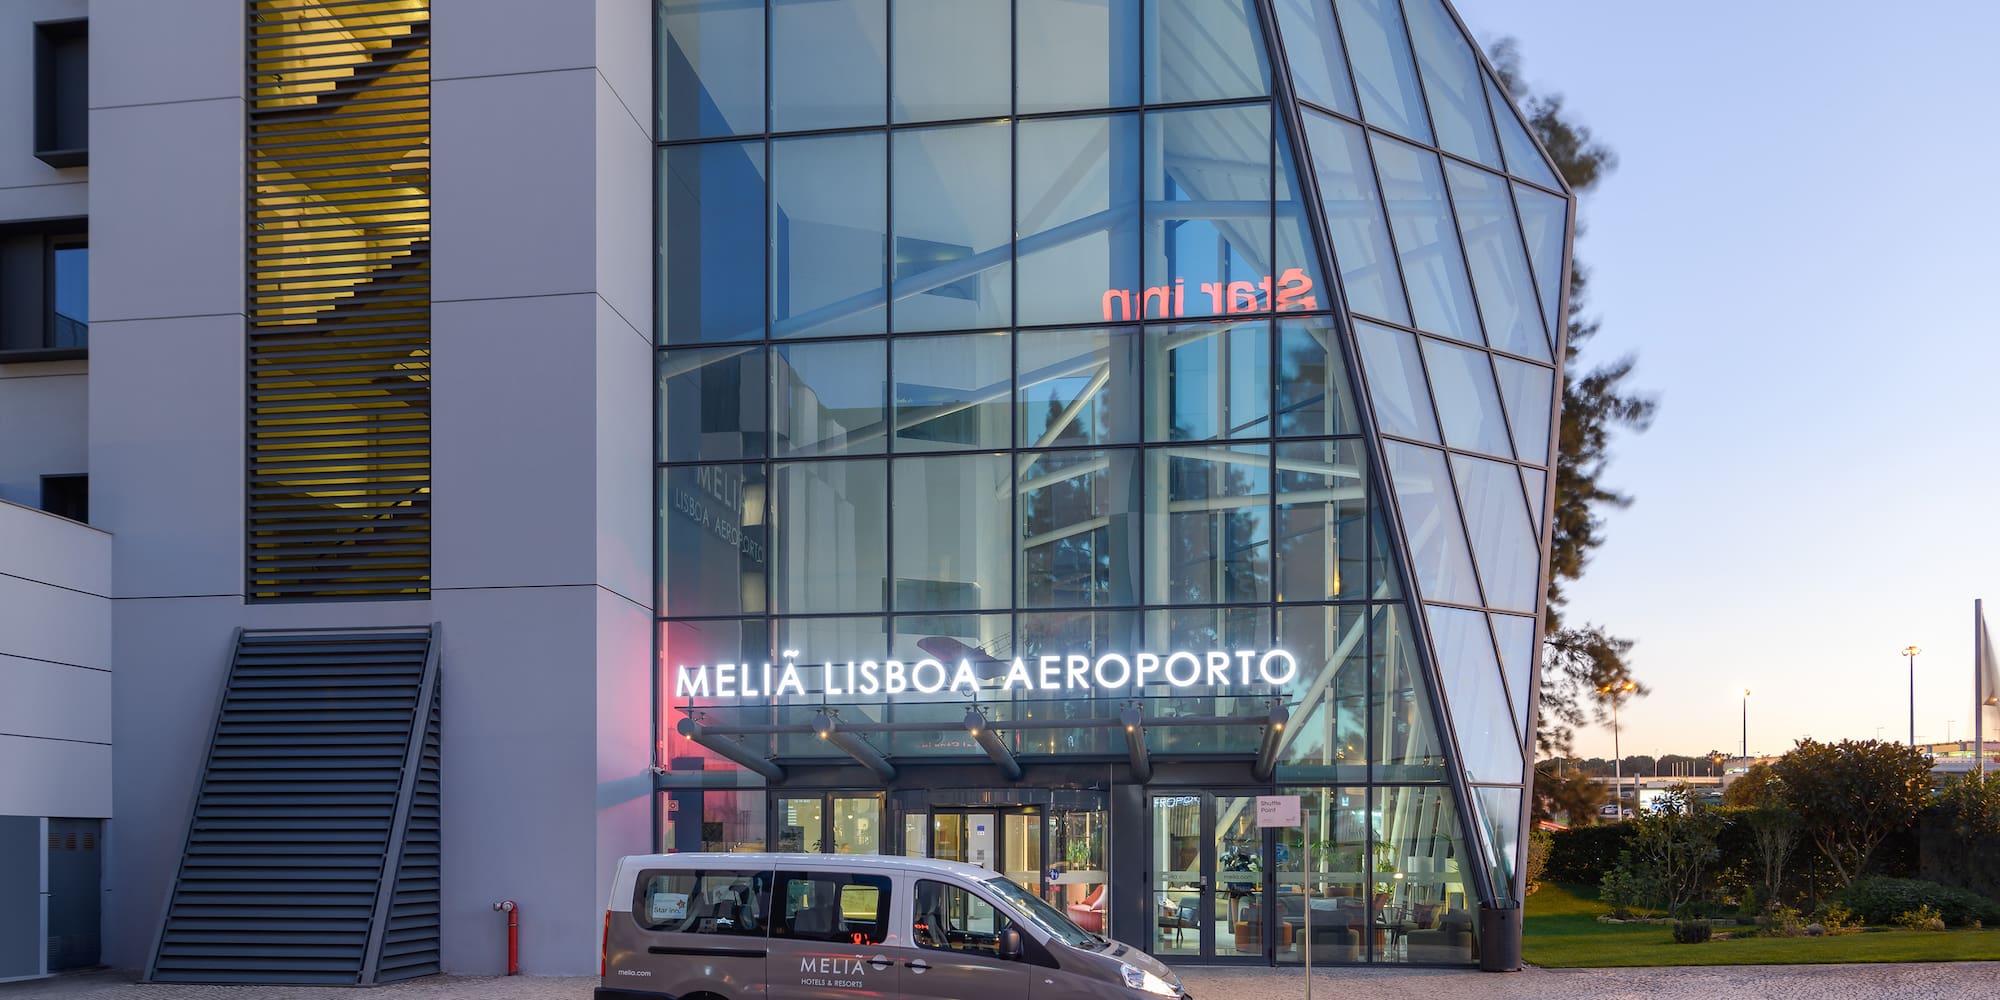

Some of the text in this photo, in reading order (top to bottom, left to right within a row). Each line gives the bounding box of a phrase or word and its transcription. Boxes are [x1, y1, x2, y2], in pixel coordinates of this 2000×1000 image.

[675, 487, 709, 527] LISBOA
[676, 649, 1296, 697] MELIÃ LISBOA AEROPORTO
[617, 969, 652, 977] melia.com
[800, 954, 865, 976] MELIÃ
[801, 978, 826, 986] HOTELS
[834, 980, 863, 988] RESORTS
